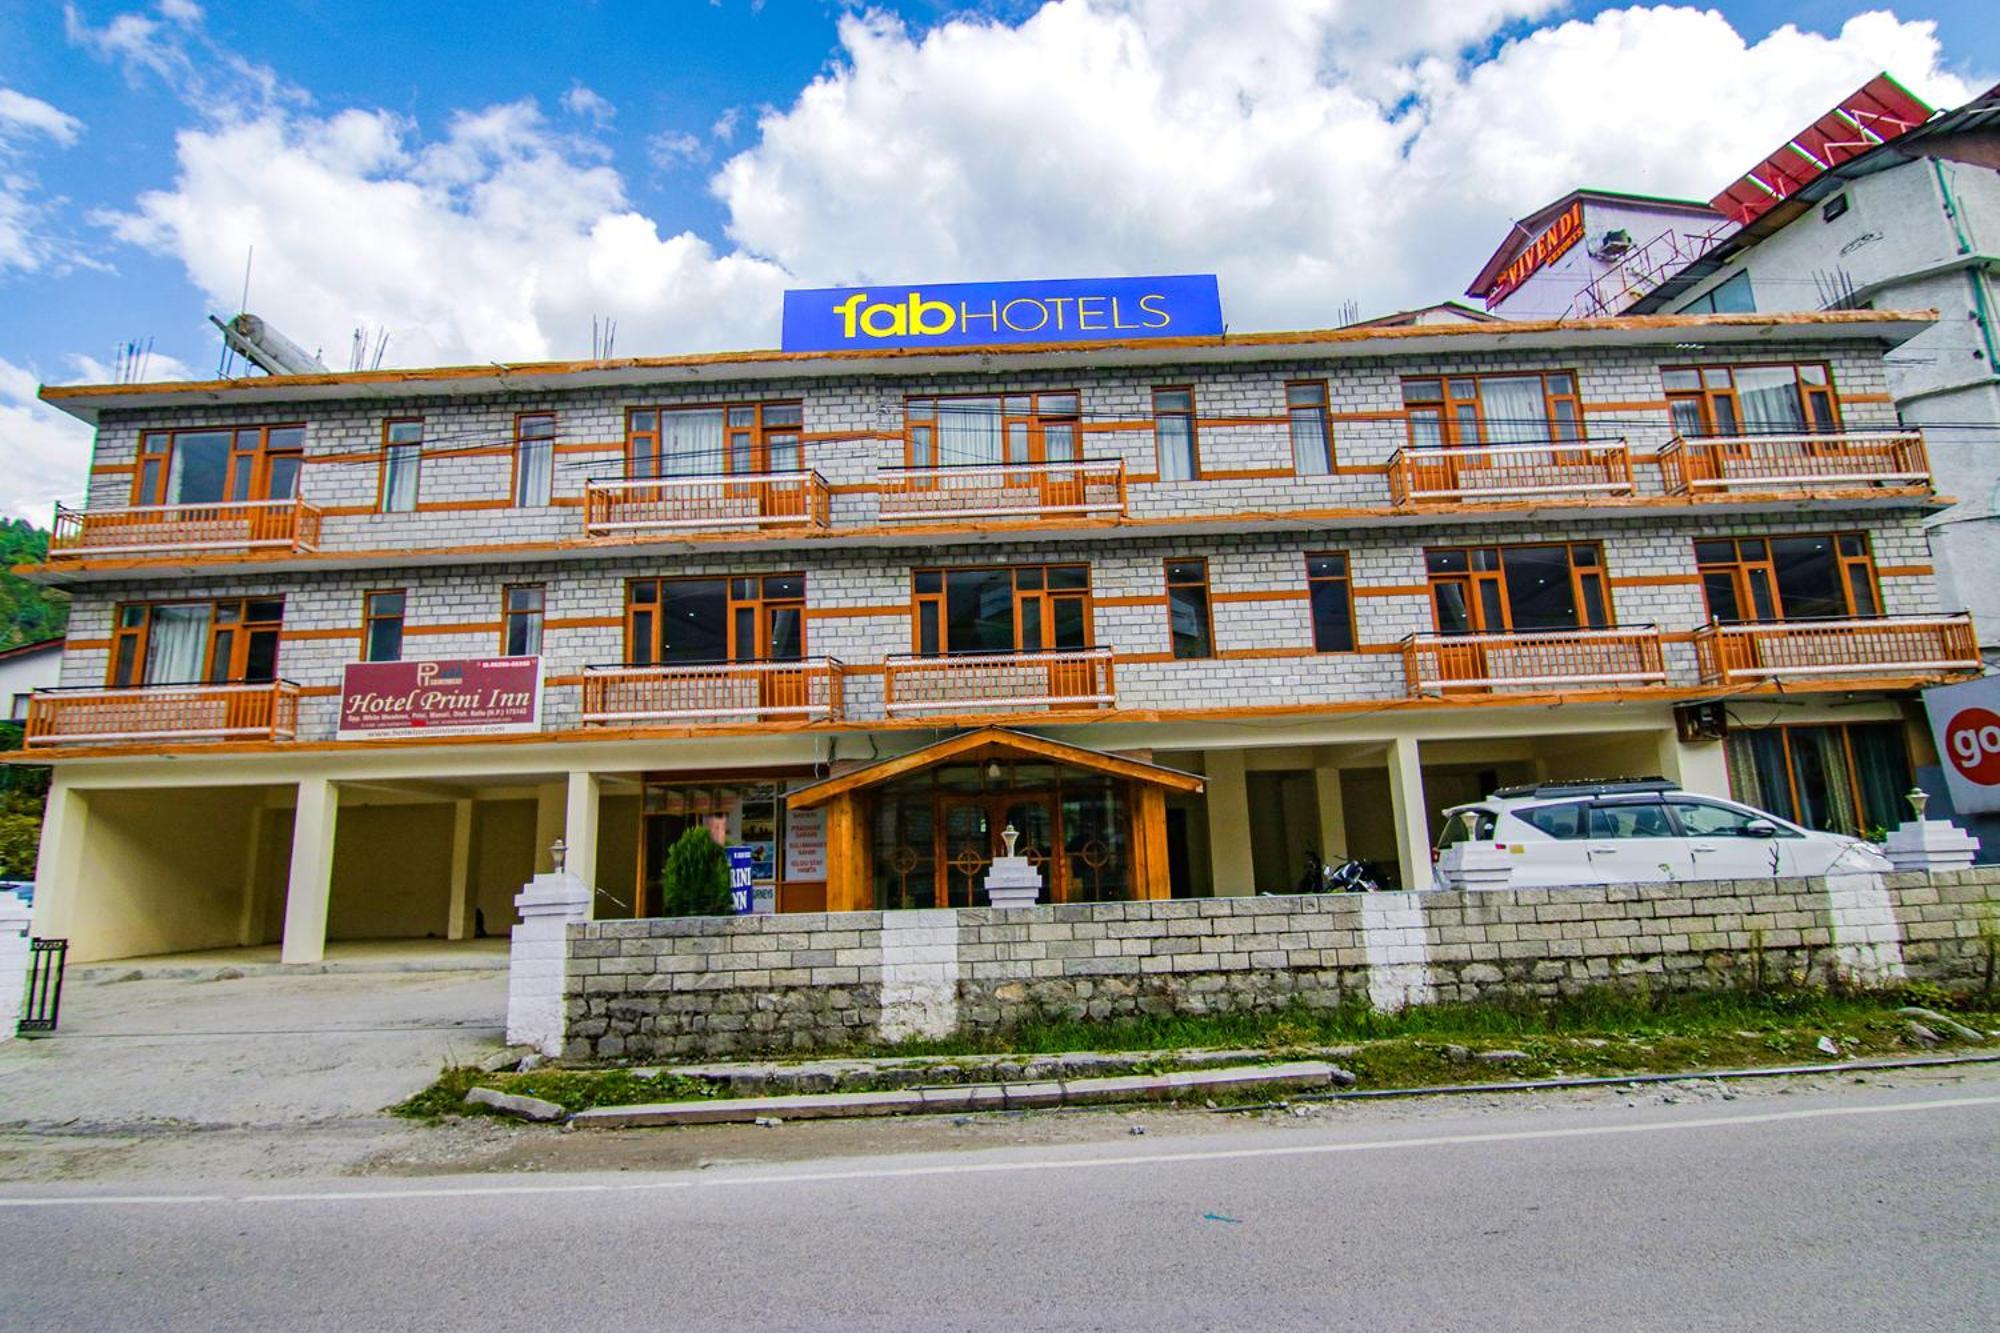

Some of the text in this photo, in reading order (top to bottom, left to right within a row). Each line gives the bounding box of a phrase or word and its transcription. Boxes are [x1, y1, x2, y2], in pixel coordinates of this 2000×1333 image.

[1509, 203, 1580, 285] VIVENDI
[346, 689, 530, 713] Hotel Prini Inn
[730, 867, 752, 888] RINI
